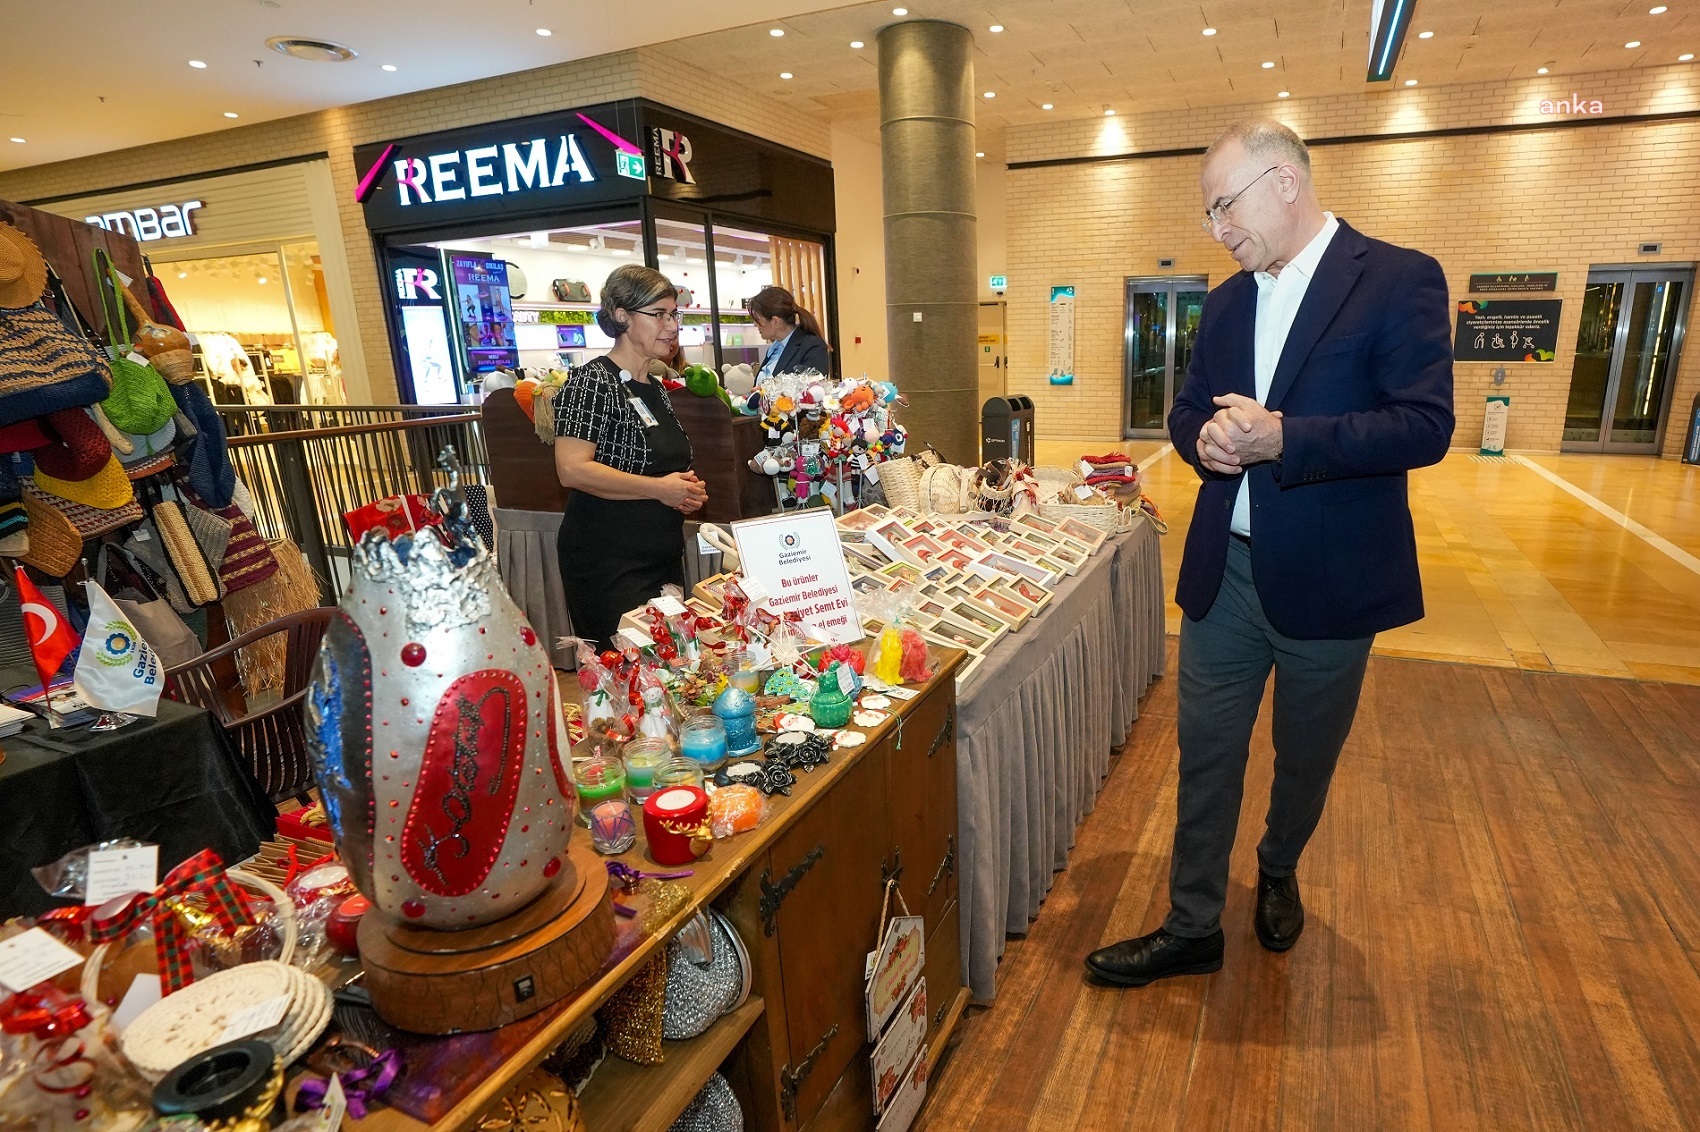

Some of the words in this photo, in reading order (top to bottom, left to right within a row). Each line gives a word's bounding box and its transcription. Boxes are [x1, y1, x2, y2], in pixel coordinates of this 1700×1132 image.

[652, 127, 662, 176] REEMA
[394, 134, 595, 206] REEMA
[468, 273, 500, 283] REEMA
[779, 549, 807, 559] Gaziemir
[779, 555, 812, 565] Belediyesi
[781, 578, 792, 588] Bu
[792, 573, 819, 586] ürünler
[769, 594, 801, 607] Gaziemir
[802, 585, 839, 600] Belediyesi
[814, 601, 836, 614] Semt
[836, 597, 849, 609] Evi
[826, 615, 848, 628] emeği
